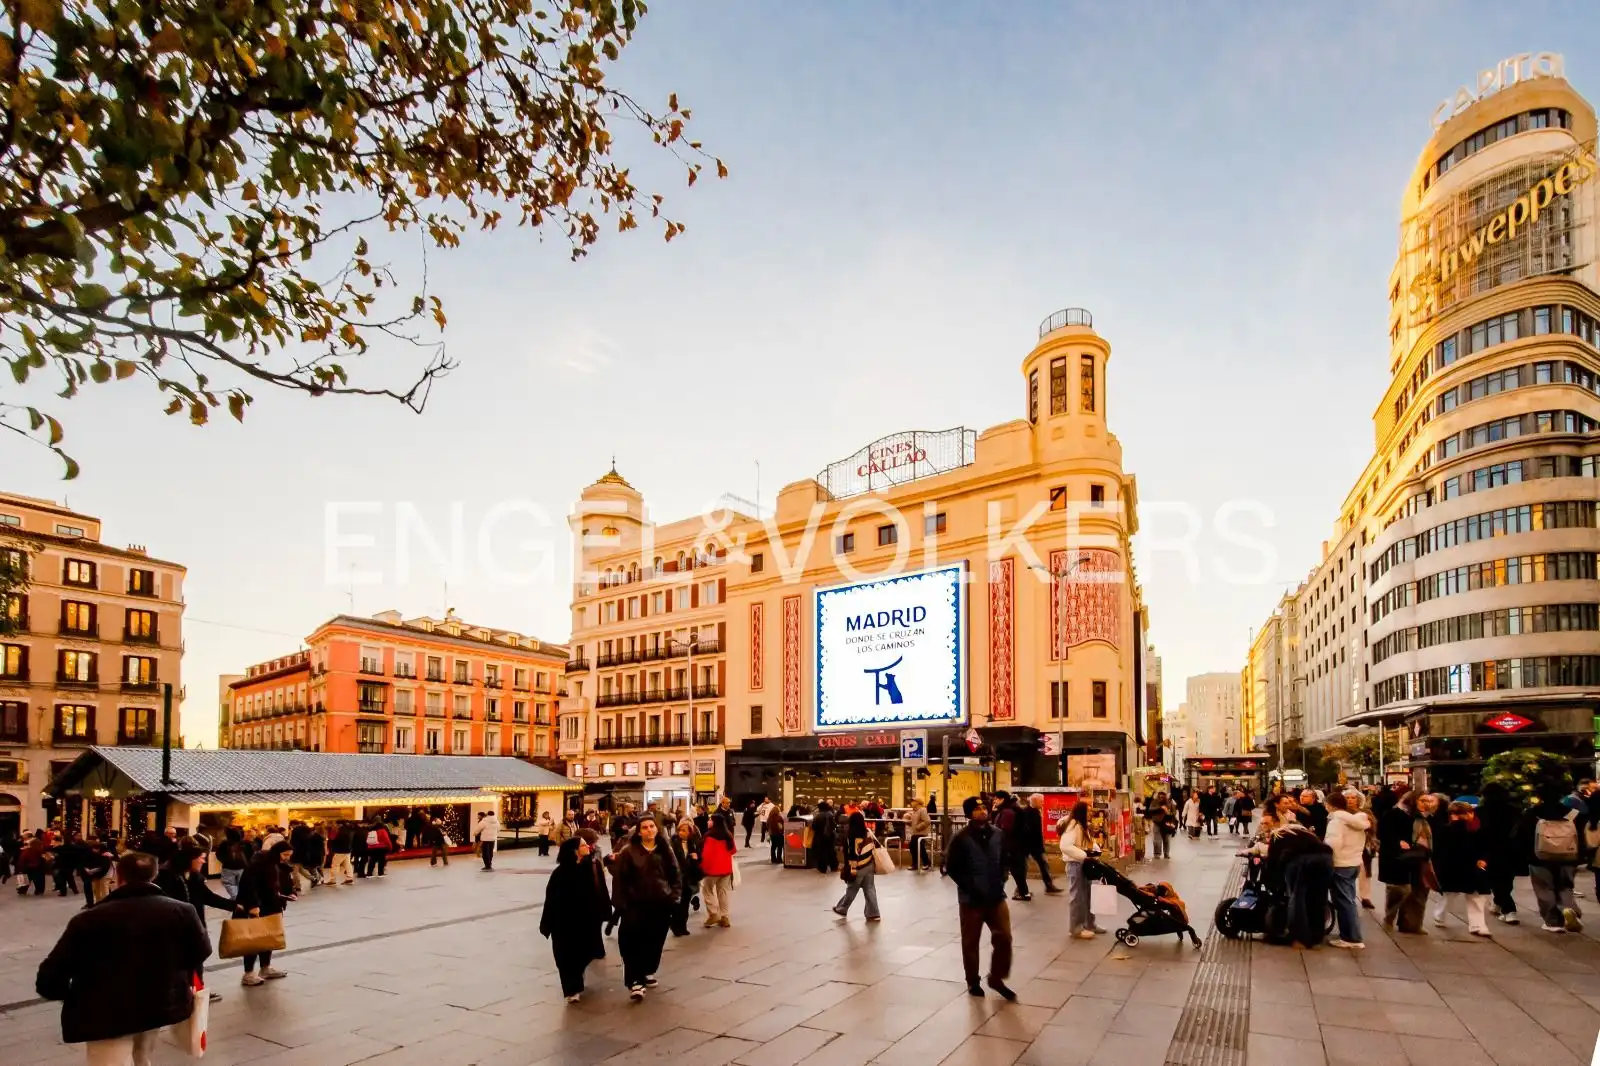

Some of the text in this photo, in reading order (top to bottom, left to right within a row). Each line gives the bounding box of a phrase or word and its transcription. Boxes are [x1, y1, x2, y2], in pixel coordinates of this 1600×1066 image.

[870, 440, 913, 460] CINES
[846, 605, 927, 632] MADRID
[845, 627, 925, 645] DONDE SE CRUZAN
[857, 639, 915, 654] LOS CAMINOS
[818, 735, 857, 748] CINES
[903, 739, 919, 758] P
